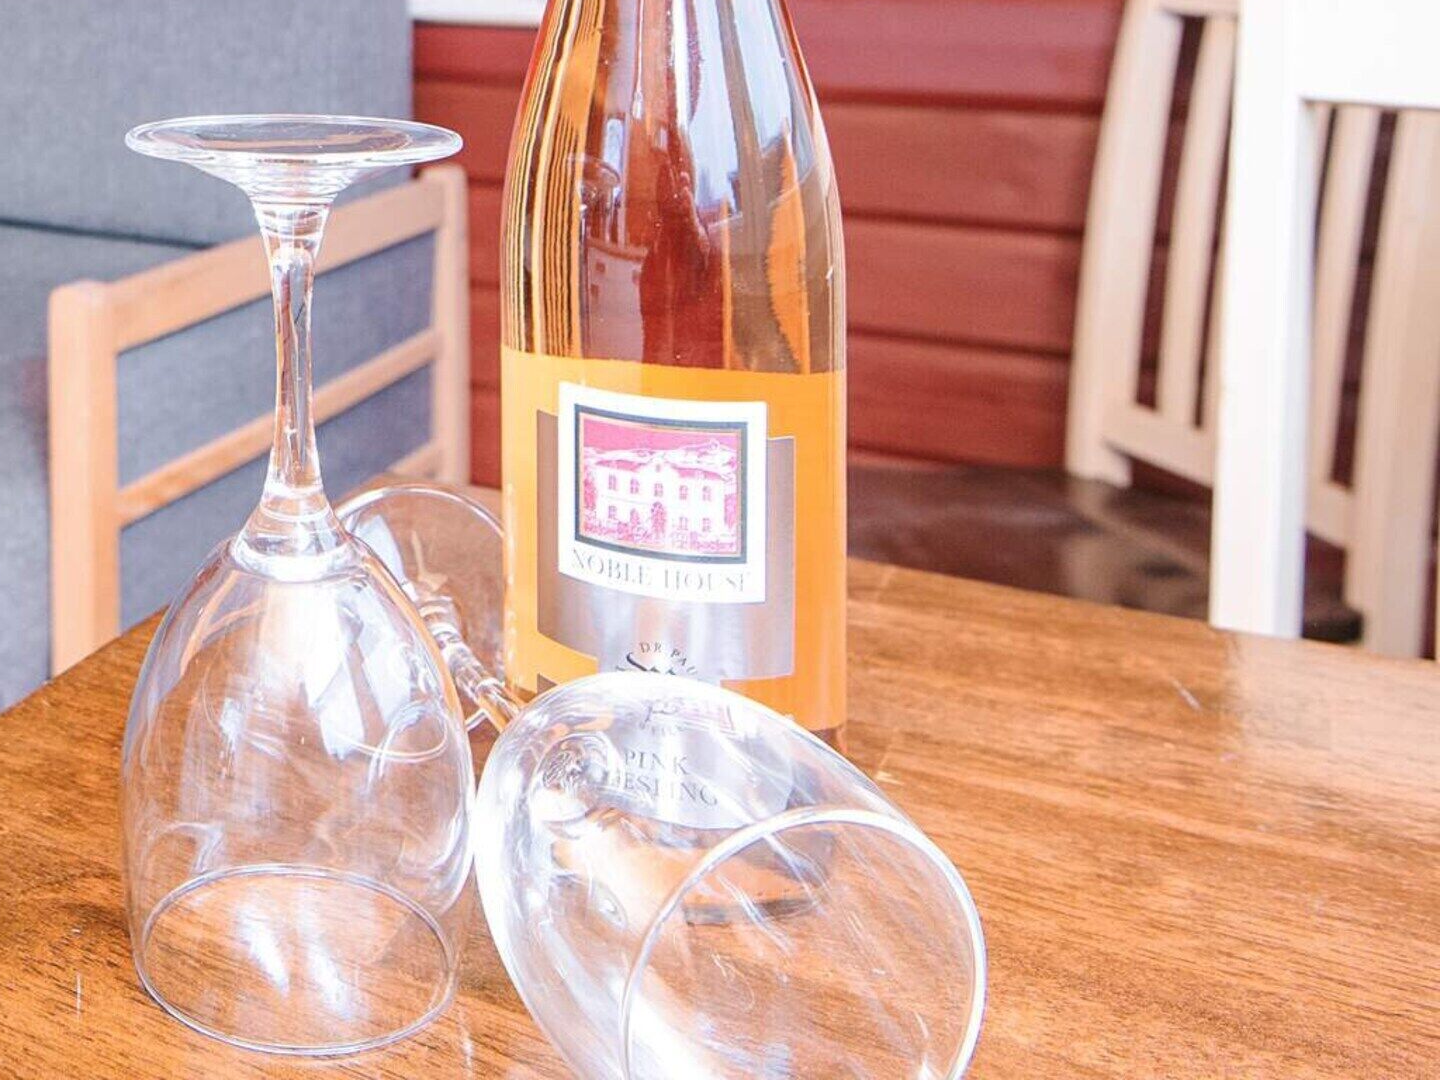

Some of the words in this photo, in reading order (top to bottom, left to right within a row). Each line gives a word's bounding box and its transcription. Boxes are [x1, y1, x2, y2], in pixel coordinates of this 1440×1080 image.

[571, 547, 652, 587] NOBLE
[664, 568, 751, 593] HOUSE
[623, 747, 689, 776] PINK
[603, 770, 718, 806] IESLING
